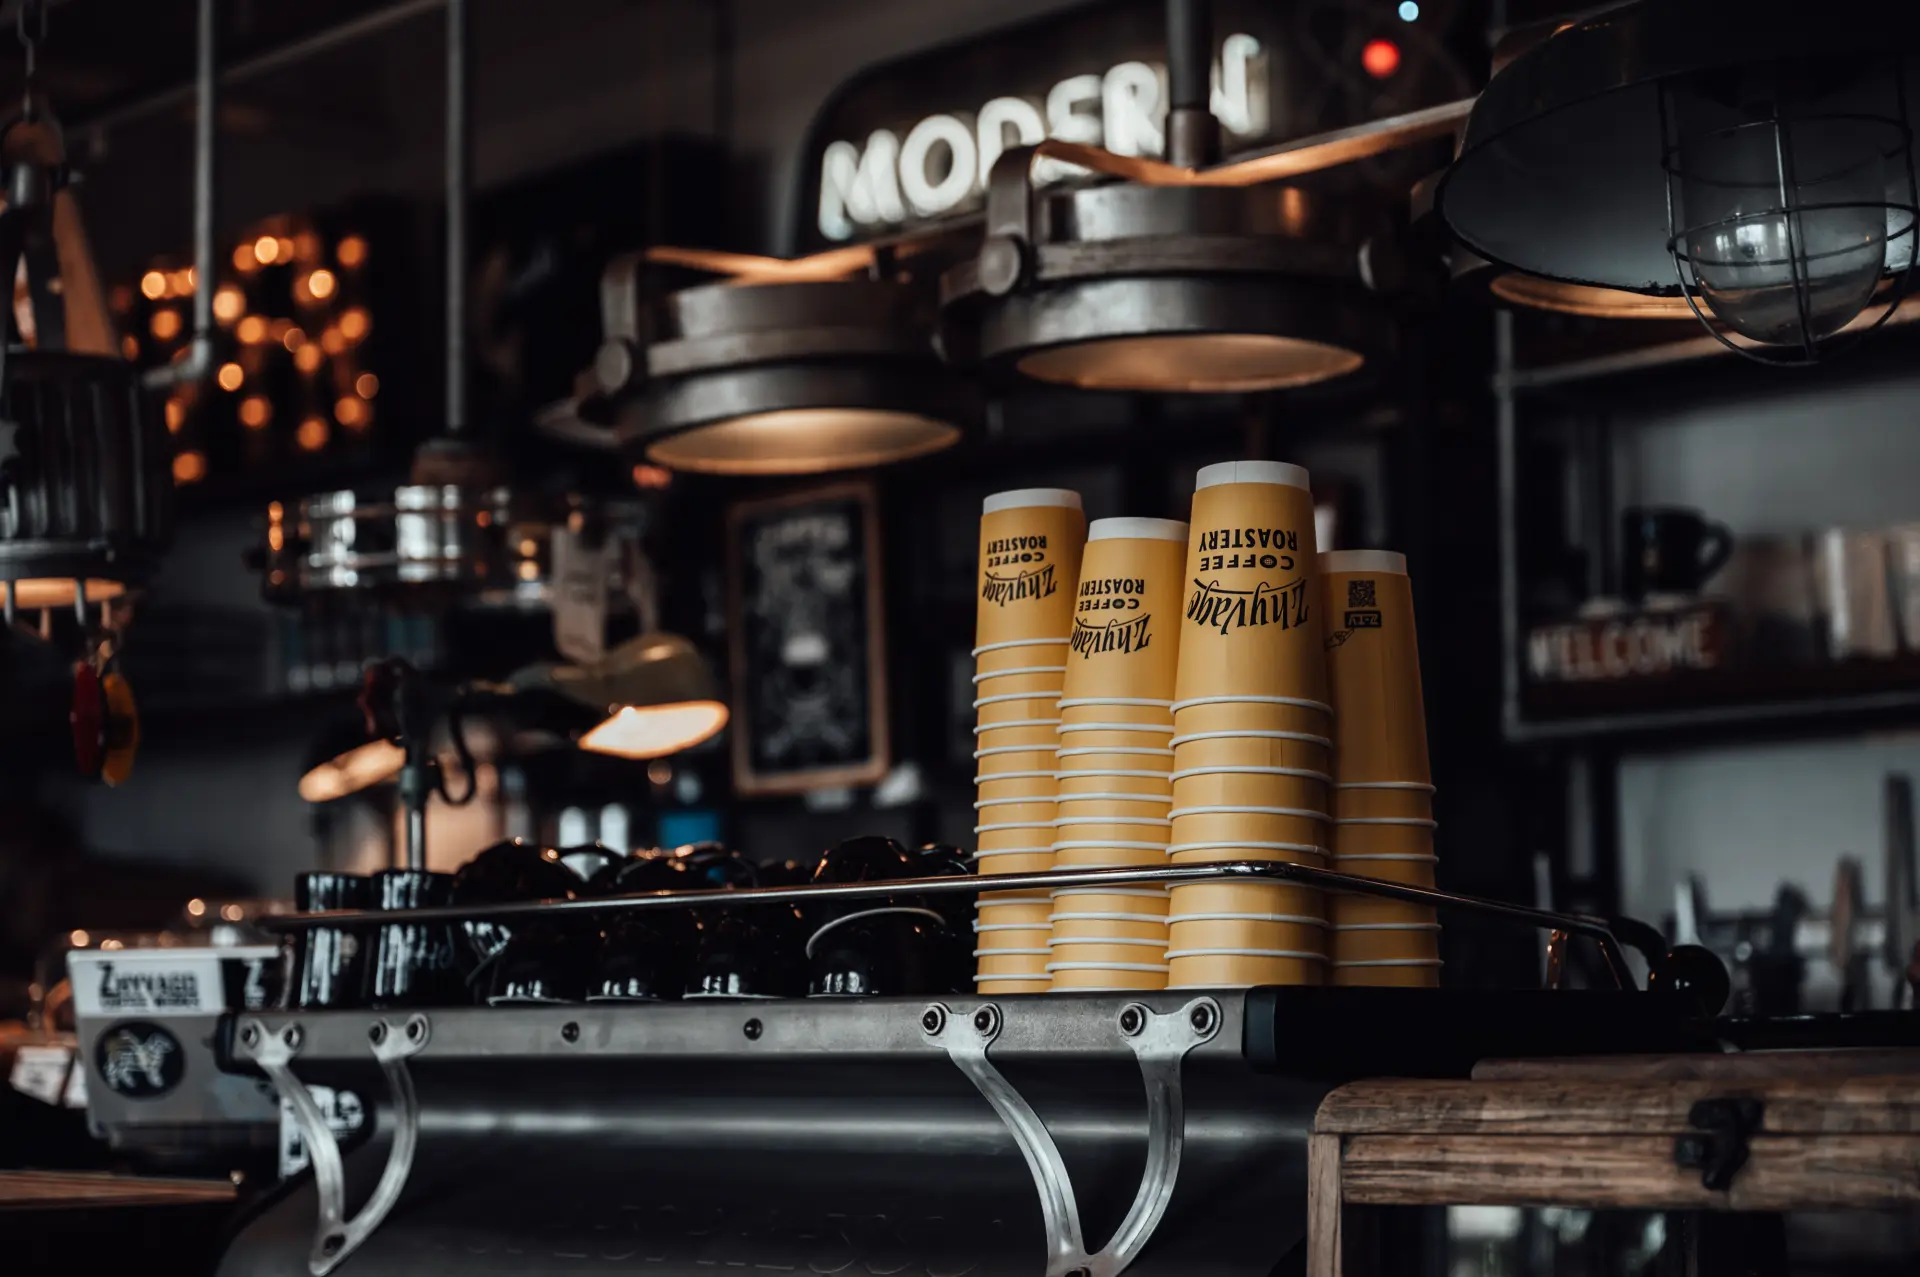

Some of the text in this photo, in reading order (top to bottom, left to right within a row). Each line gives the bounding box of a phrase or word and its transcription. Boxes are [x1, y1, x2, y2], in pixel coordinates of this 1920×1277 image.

[986, 535, 1047, 555] ROASTERY
[1199, 528, 1298, 552] ROASTERY
[988, 552, 1045, 568] COFFEE
[1200, 554, 1295, 572] COFFEE
[982, 564, 1058, 607] Zhyvago
[1080, 578, 1145, 597] ROASTERY
[1079, 598, 1140, 612] COFFEE
[1187, 577, 1309, 635] Zhyvago
[1070, 612, 1152, 659] Zhyvago
[1527, 611, 1717, 682] WELCOME
